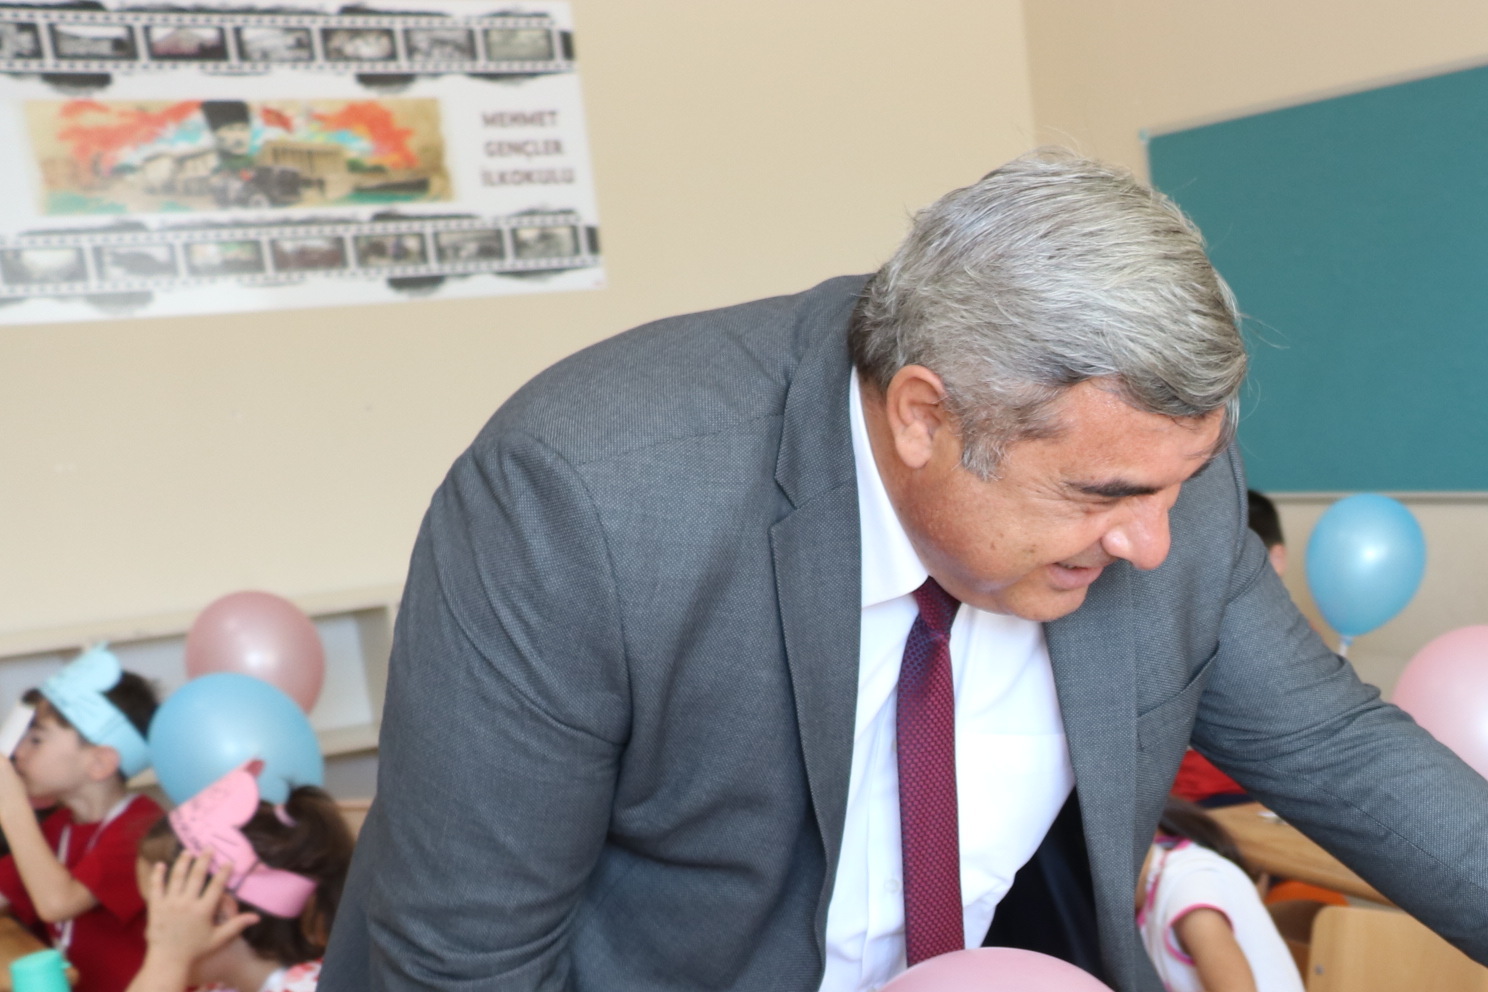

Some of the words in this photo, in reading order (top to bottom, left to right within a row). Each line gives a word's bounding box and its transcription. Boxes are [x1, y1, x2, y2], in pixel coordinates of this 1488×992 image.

[481, 109, 558, 128] MEHMET
[485, 138, 565, 161] GENÇLER
[480, 166, 575, 187] İLKOKULU
